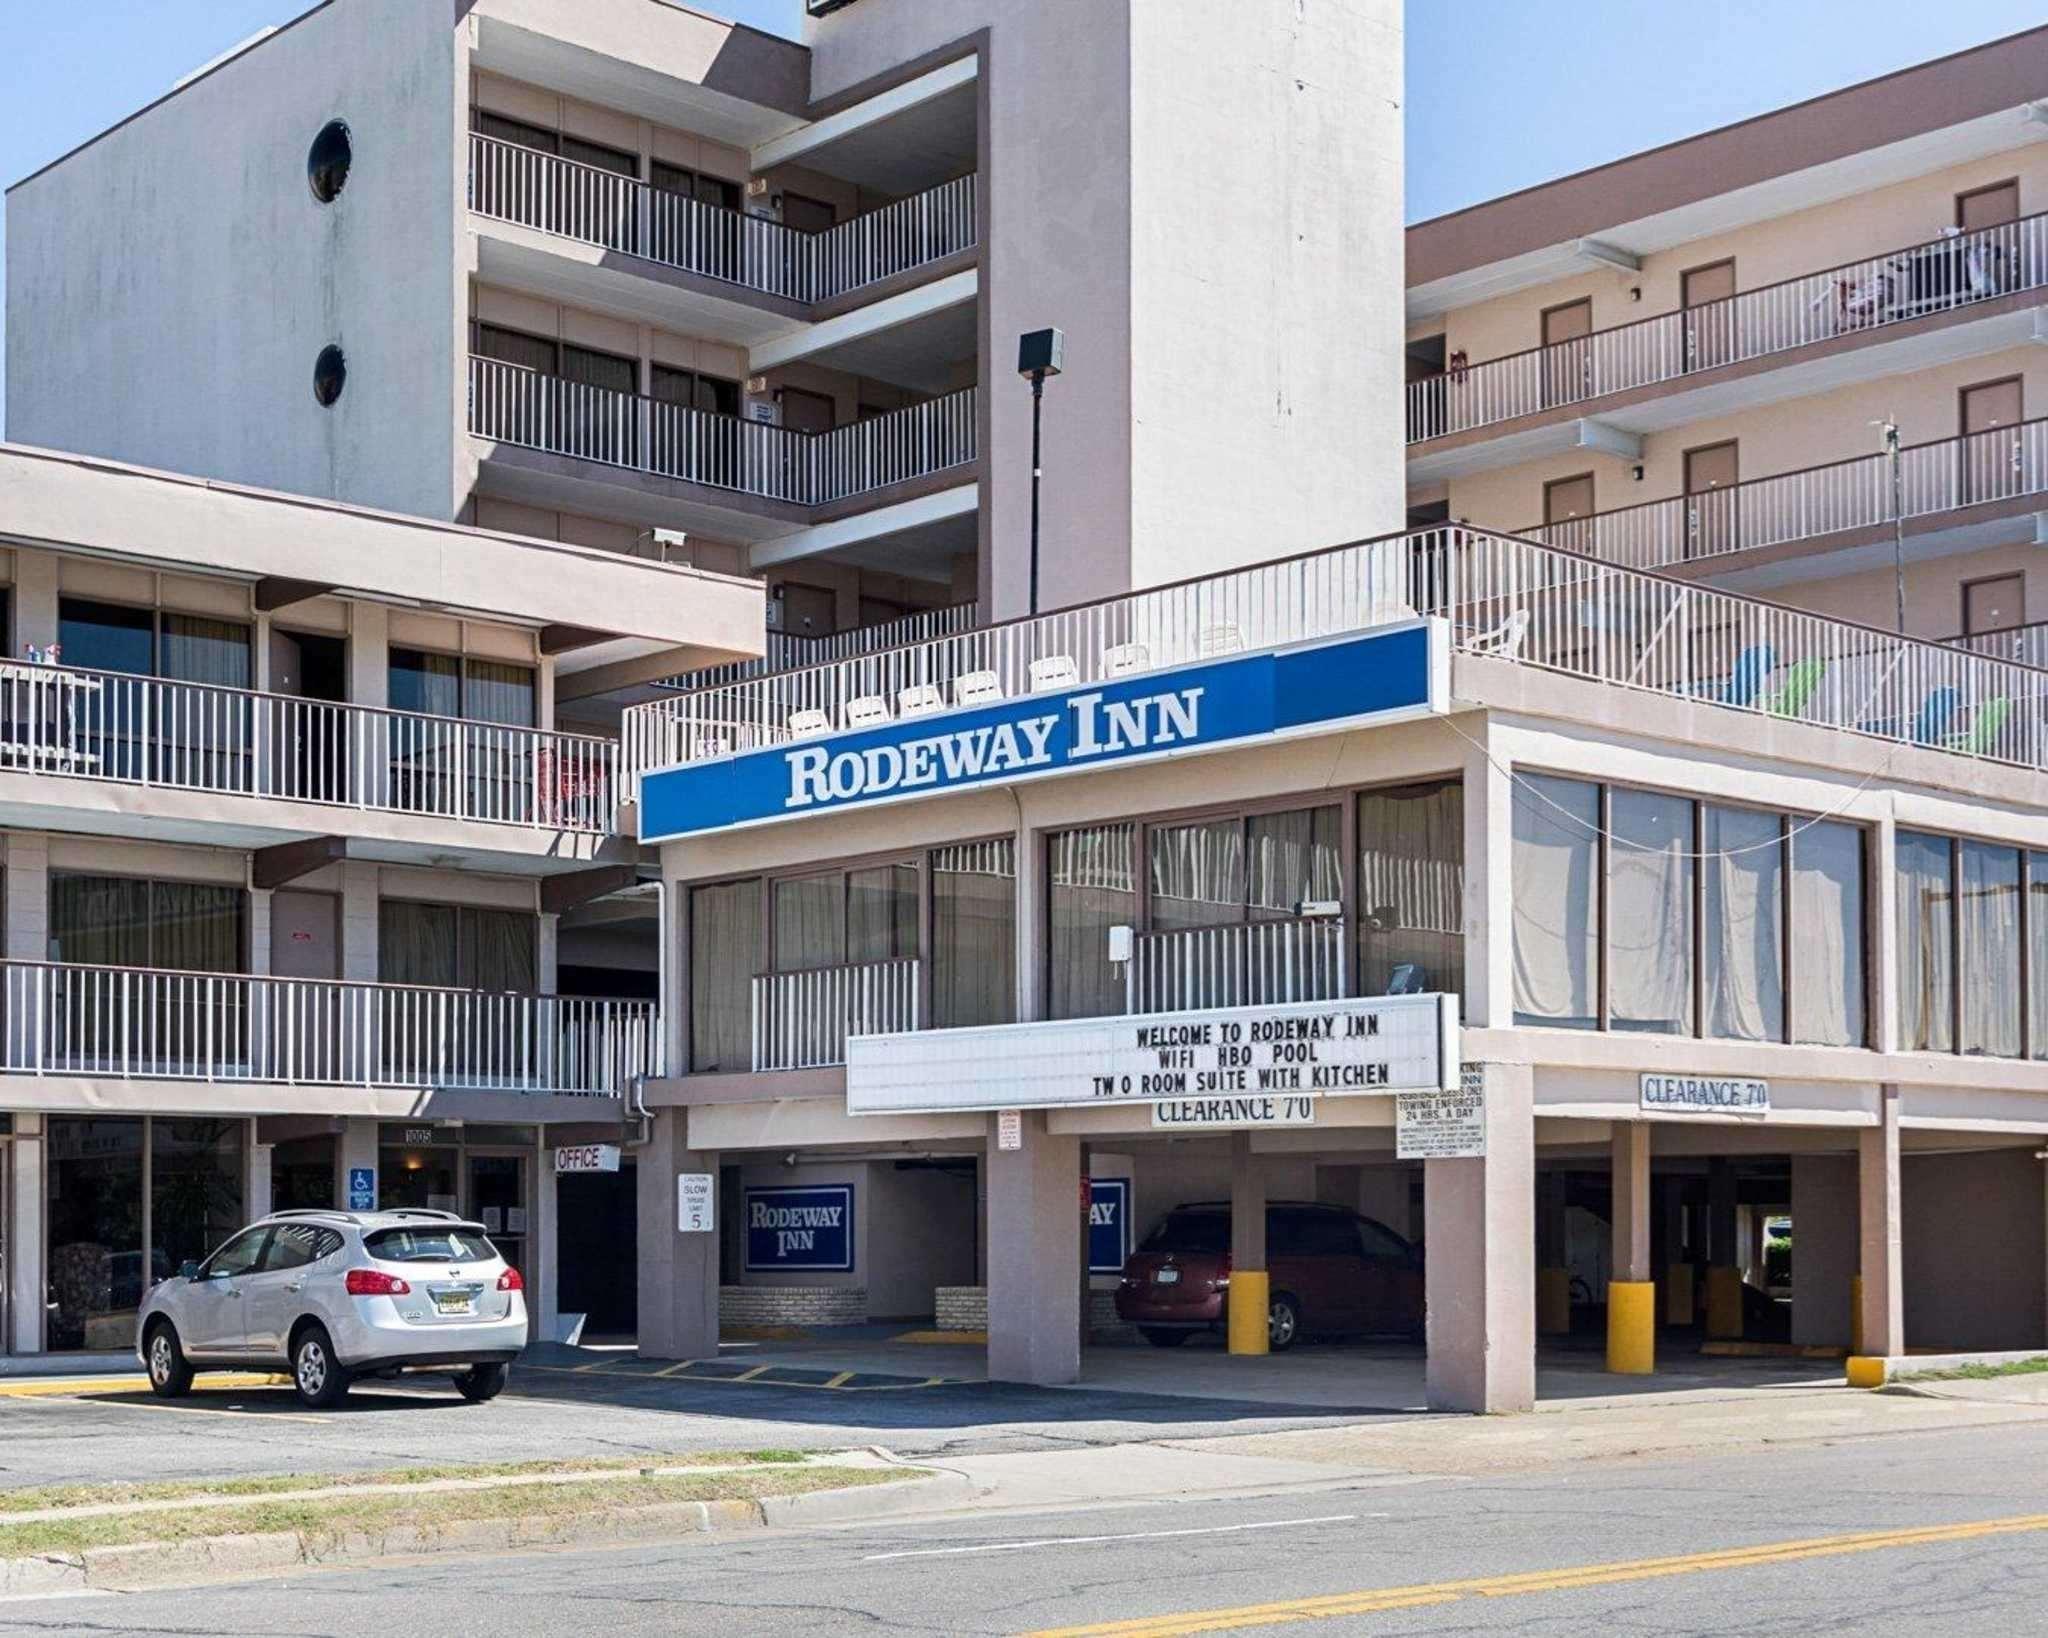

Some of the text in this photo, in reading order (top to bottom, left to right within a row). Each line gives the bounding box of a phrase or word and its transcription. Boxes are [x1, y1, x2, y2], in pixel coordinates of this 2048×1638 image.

[785, 687, 1204, 808] RODEWAY INN
[1137, 1014, 1378, 1047] WELCOME TO RODEWAY INN
[1159, 1042, 1318, 1069] WIFI HBO POOL
[1142, 1073, 1186, 1094] ROOM
[1196, 1070, 1246, 1091] SUITE
[1258, 1067, 1300, 1089] WITH
[1312, 1063, 1389, 1088] KITCHEN
[1645, 1078, 1741, 1106] CLEARANCE
[1158, 1097, 1274, 1122] CLEARANCE
[1400, 1097, 1483, 1111] TOWING ENFORCED
[1406, 1111, 1417, 1121] 24
[1446, 1109, 1453, 1118] A
[1456, 1108, 1474, 1118] DAY
[559, 1147, 600, 1169] OFFICE
[684, 1185, 707, 1194] SLOW
[692, 1214, 702, 1229] 5
[751, 1202, 842, 1229] RODEWAY
[777, 1230, 815, 1257] INN
